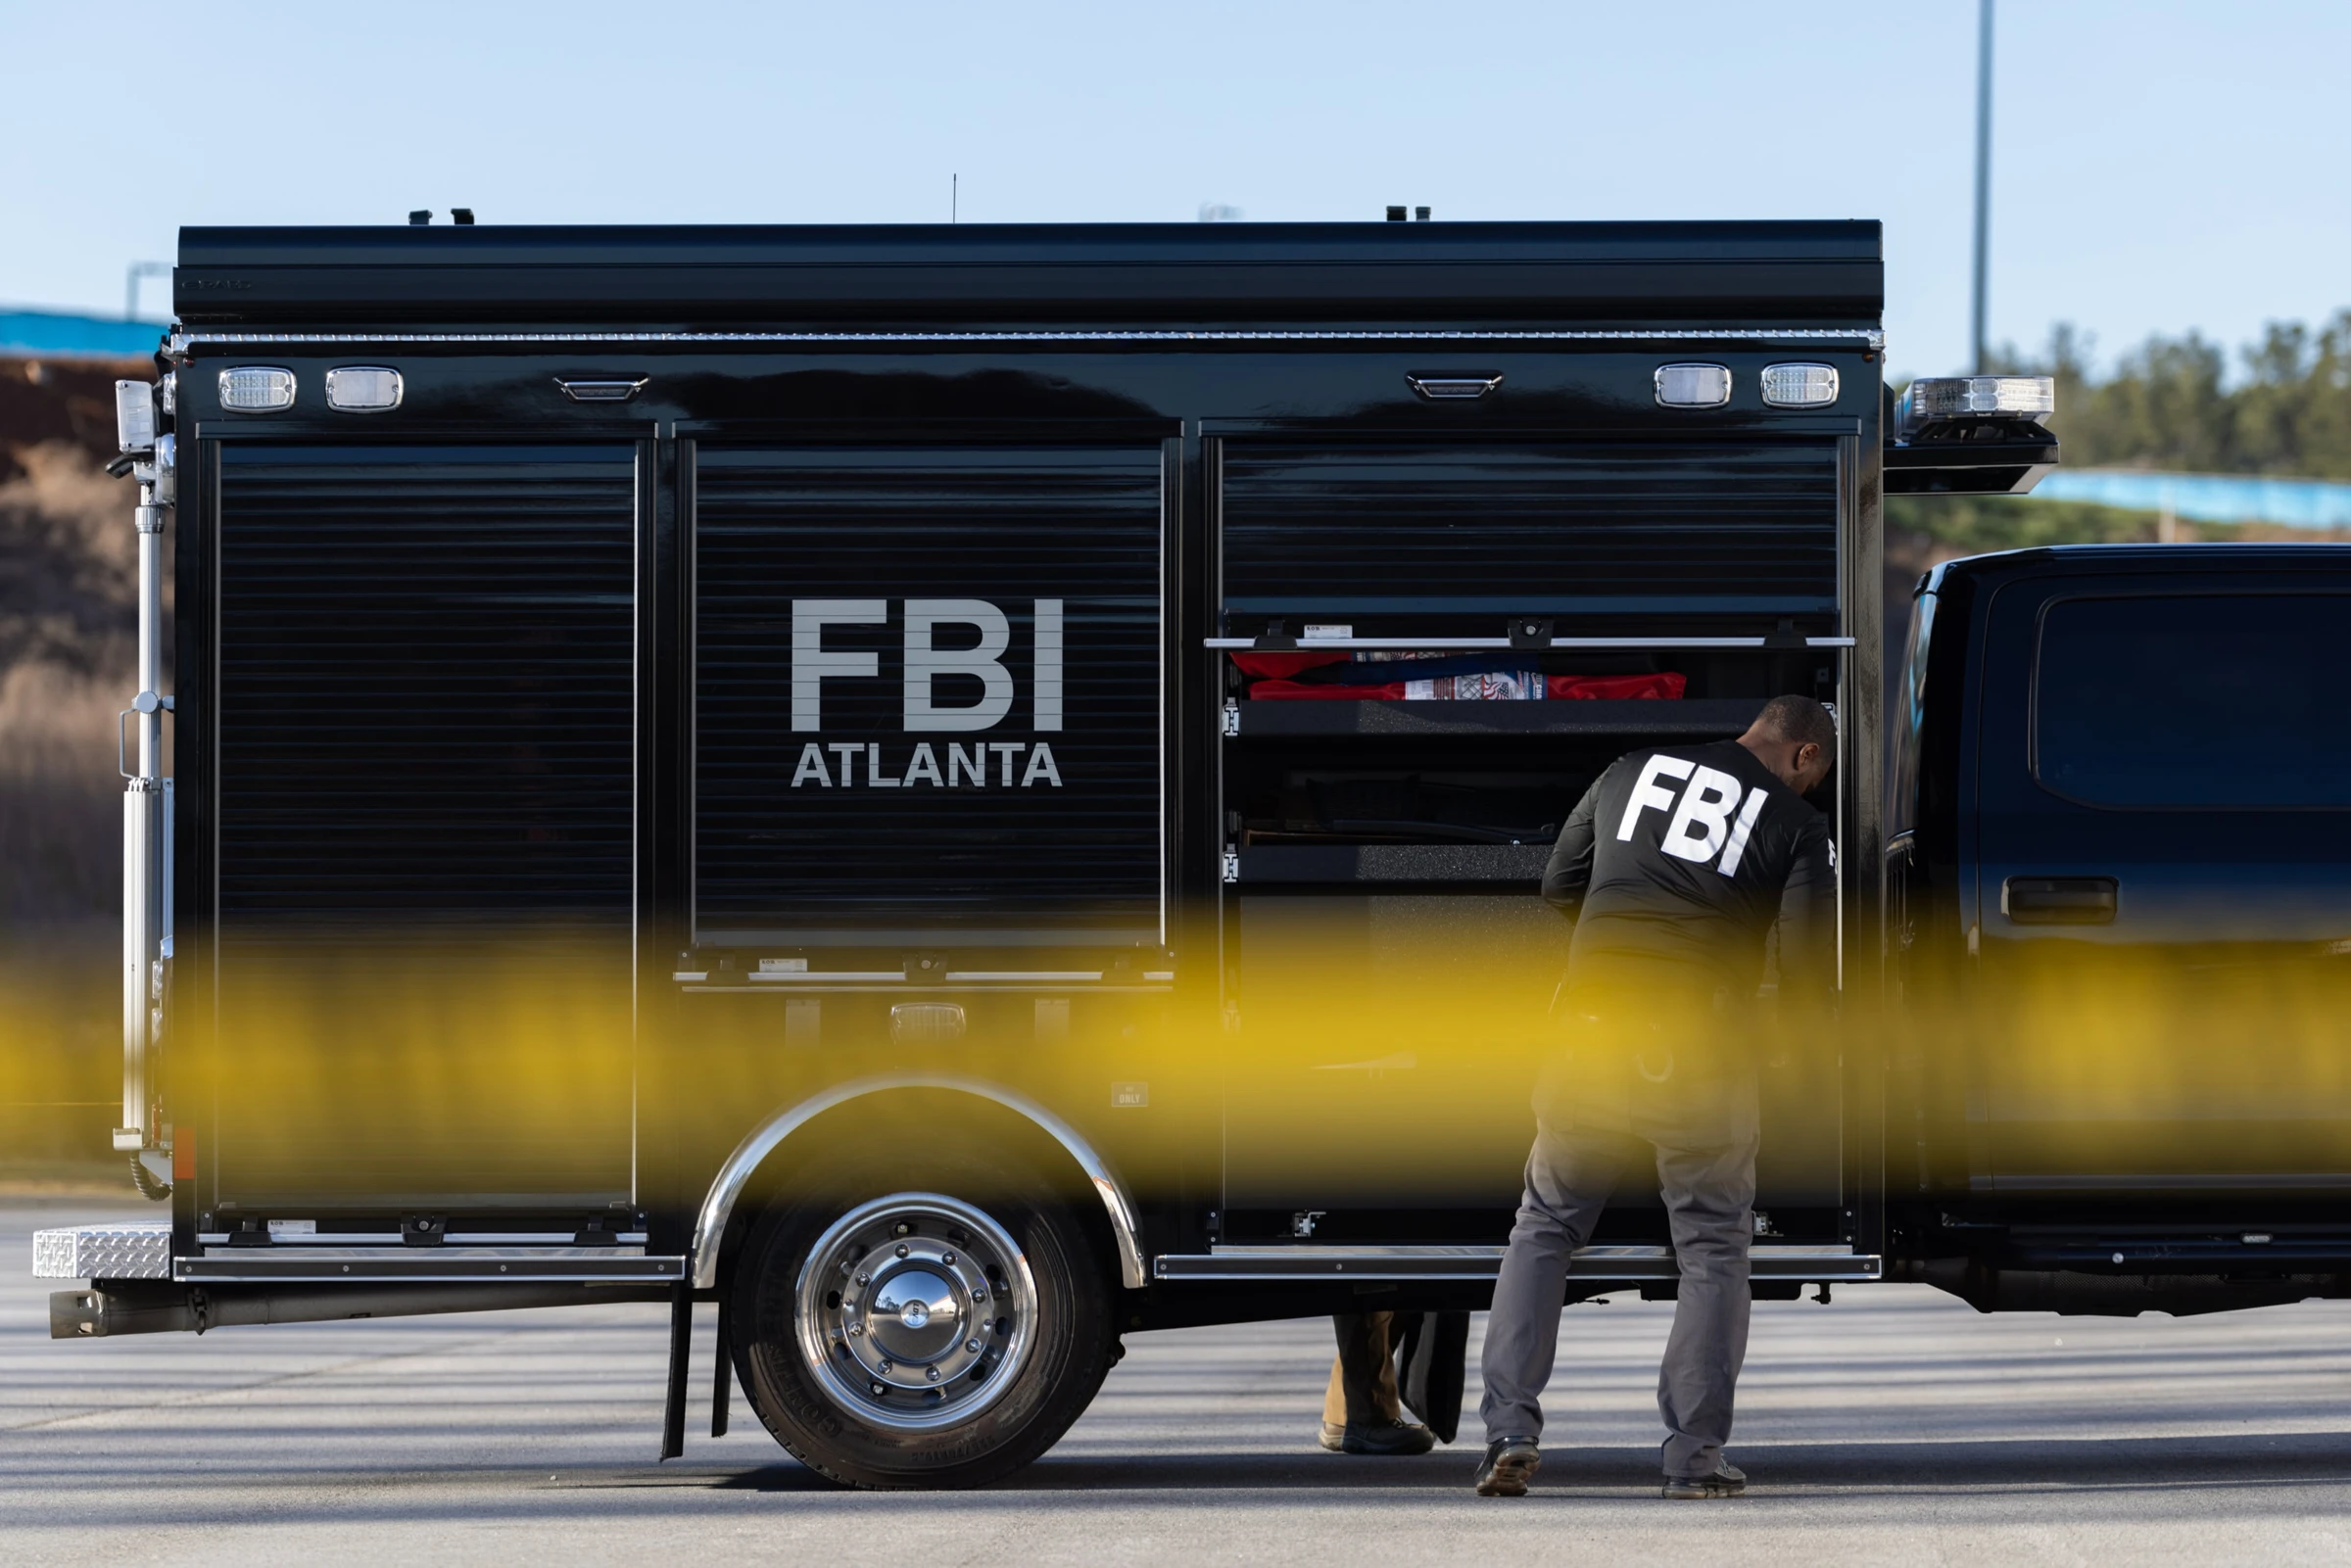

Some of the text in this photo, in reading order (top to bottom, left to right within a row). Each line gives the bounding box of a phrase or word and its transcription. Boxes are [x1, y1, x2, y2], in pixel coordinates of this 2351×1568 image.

[792, 599, 1063, 732] FBI
[791, 742, 1063, 787] ATLANTA
[1616, 753, 1769, 878] FBI
[1119, 1093, 1140, 1104] ONLY
